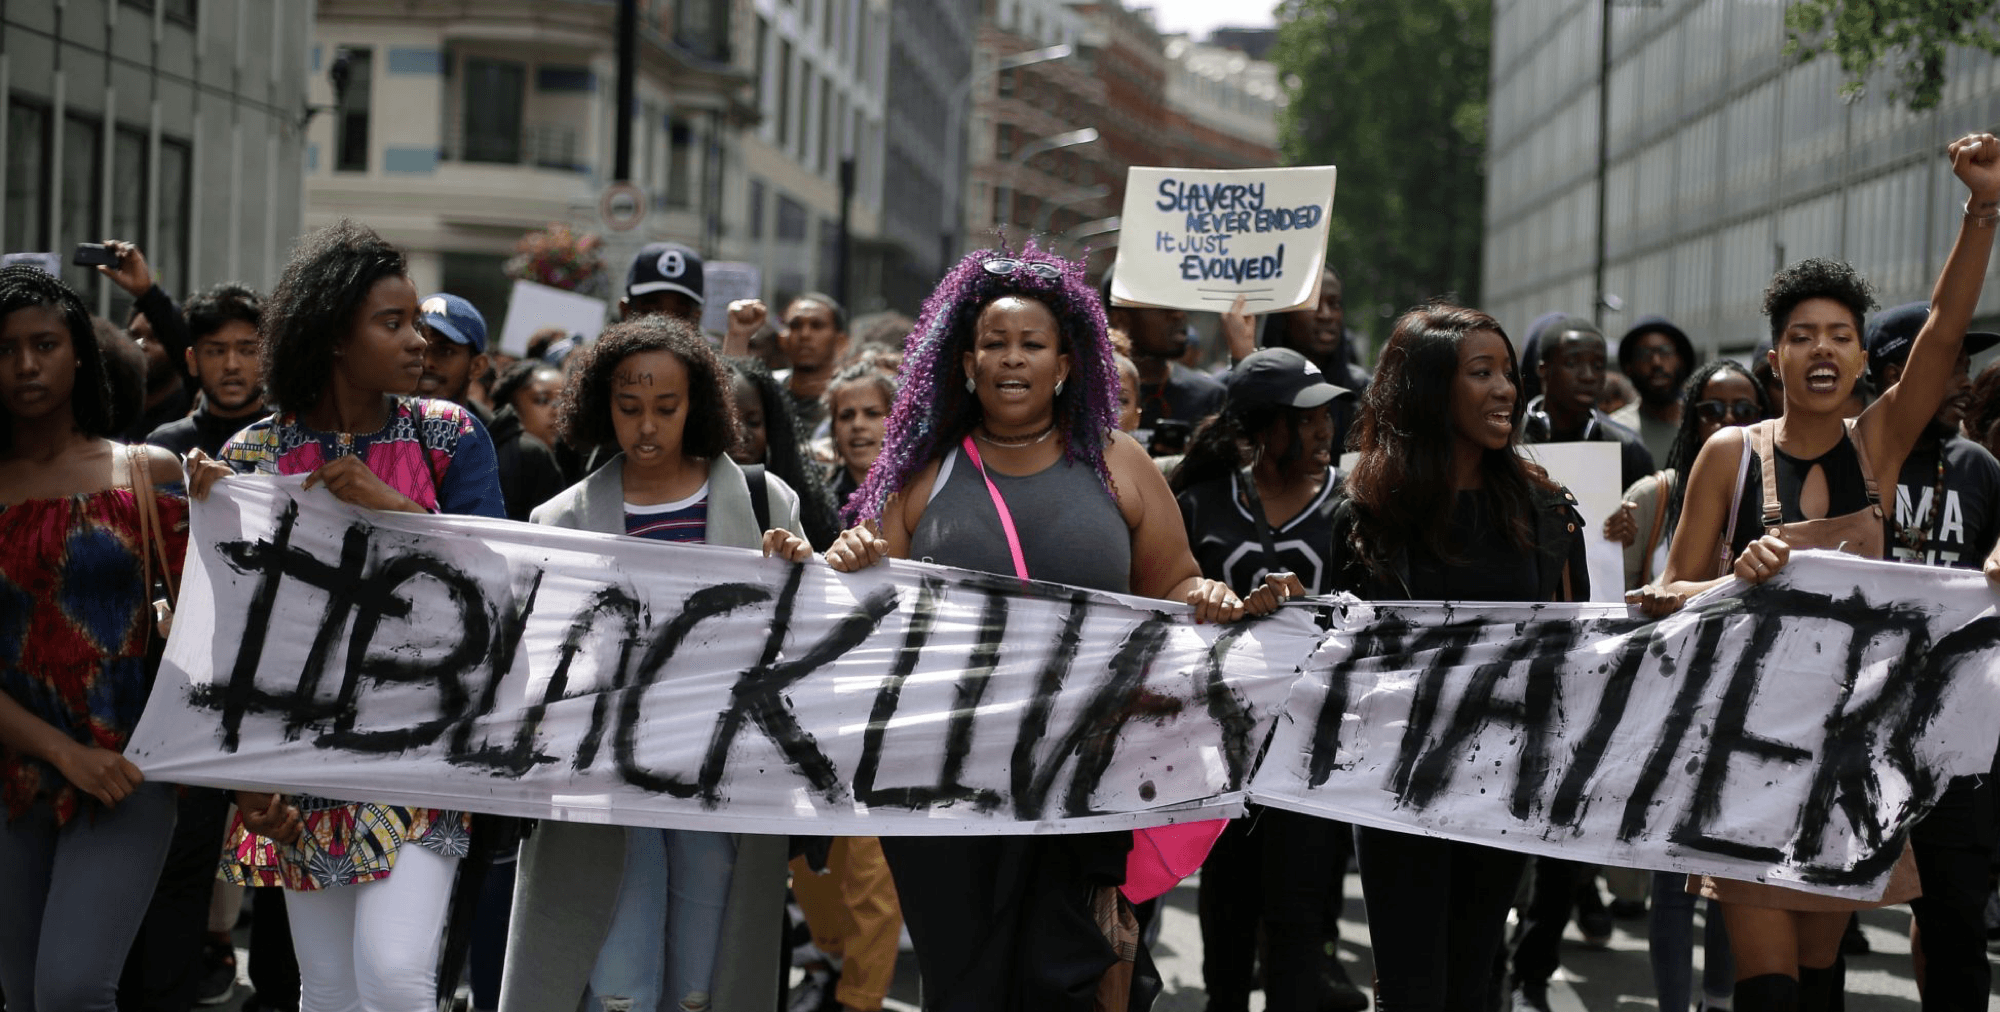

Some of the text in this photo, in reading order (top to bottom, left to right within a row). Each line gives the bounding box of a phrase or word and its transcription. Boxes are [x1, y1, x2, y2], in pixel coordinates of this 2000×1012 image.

[1156, 178, 1265, 212] SLAVERY
[1186, 204, 1323, 234] NEVER ENDED
[1178, 233, 1233, 255] JUST
[1179, 243, 1285, 285] EVOLVED!
[619, 369, 653, 388] BLM
